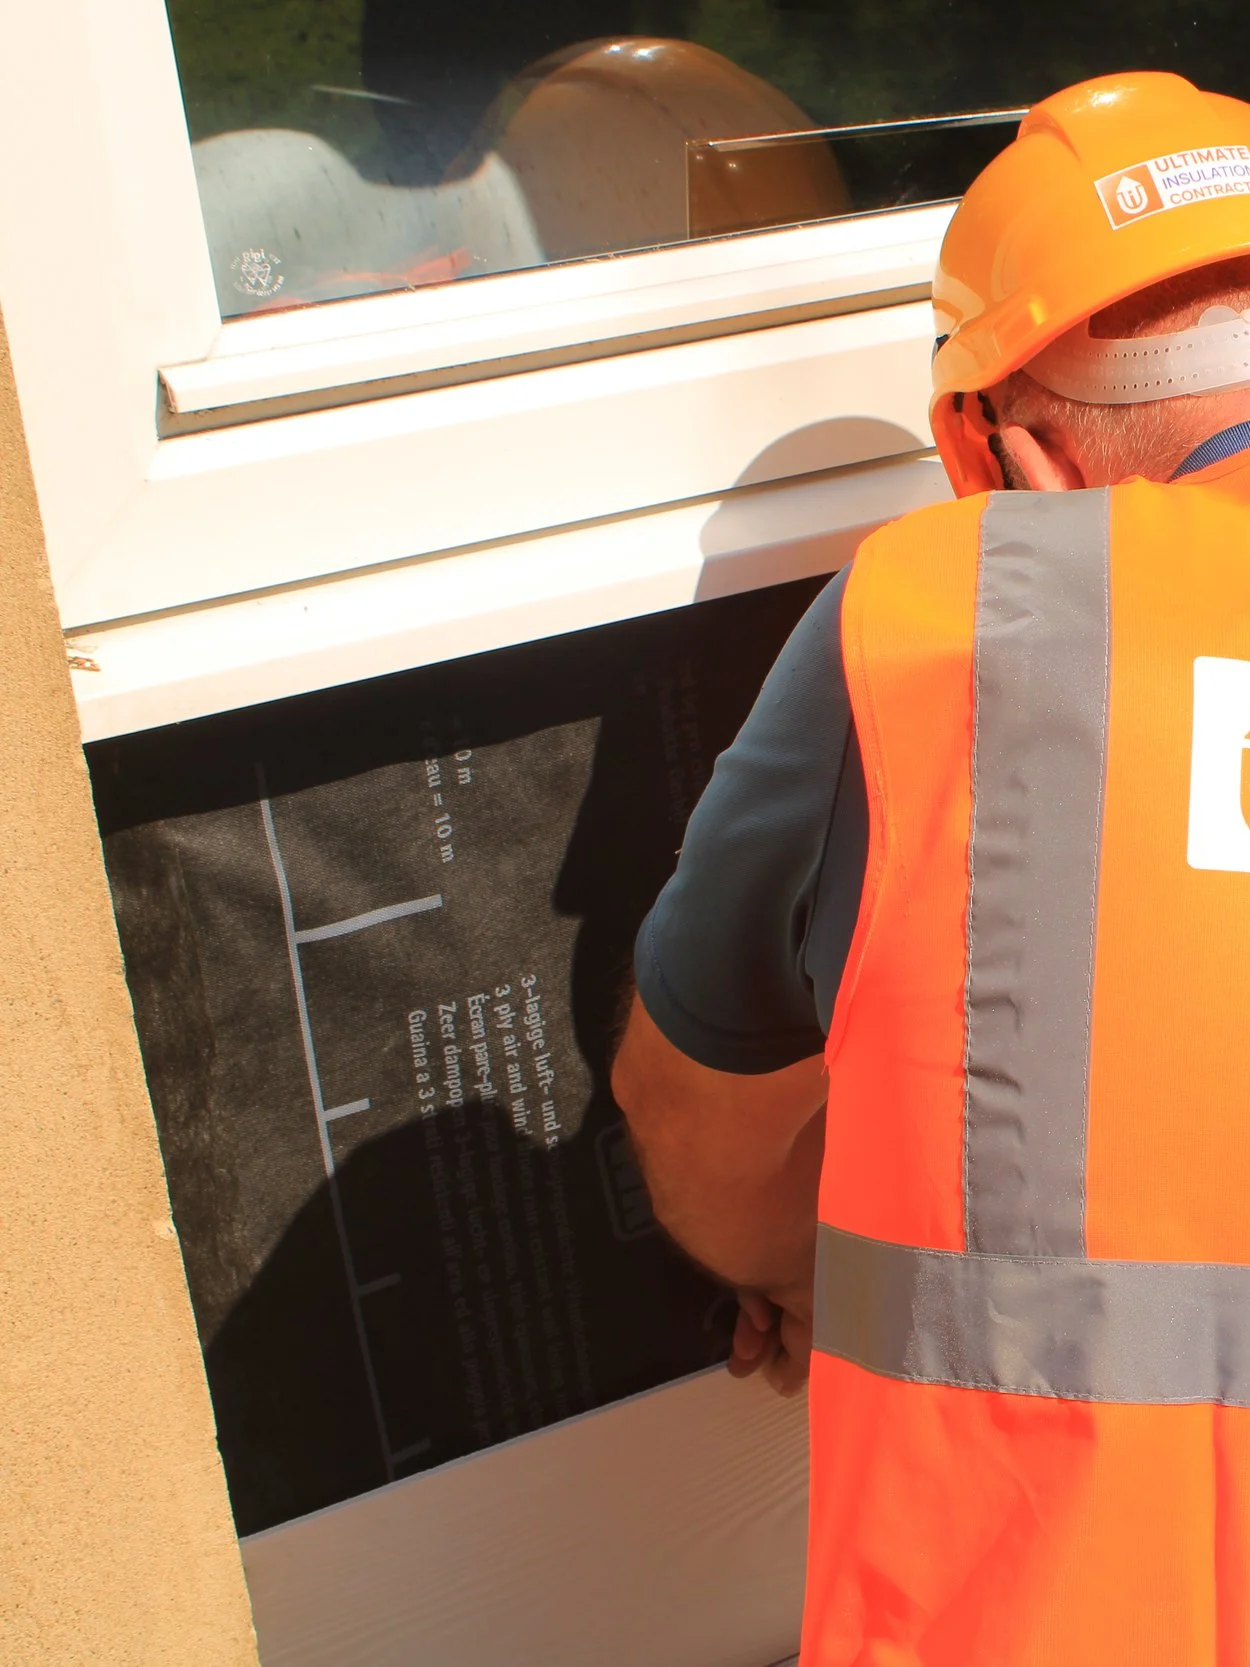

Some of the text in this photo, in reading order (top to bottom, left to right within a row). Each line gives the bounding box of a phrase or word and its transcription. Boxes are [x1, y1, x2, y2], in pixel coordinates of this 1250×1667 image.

[1155, 148, 1250, 172] ULTIMATE
[435, 812, 453, 839] 10
[440, 843, 455, 864] m
[494, 984, 511, 999] 3
[437, 1001, 458, 1040] Zeer
[467, 992, 492, 1040] Écran
[493, 1002, 516, 1030] ply
[520, 973, 548, 1051] 3-lagige
[408, 1010, 431, 1066] Guaina
[502, 1035, 520, 1058] air
[417, 1072, 430, 1082] a
[506, 1062, 527, 1094] and
[533, 1053, 555, 1096] luft-
[419, 1086, 435, 1099] 3
[540, 1101, 562, 1132] und
